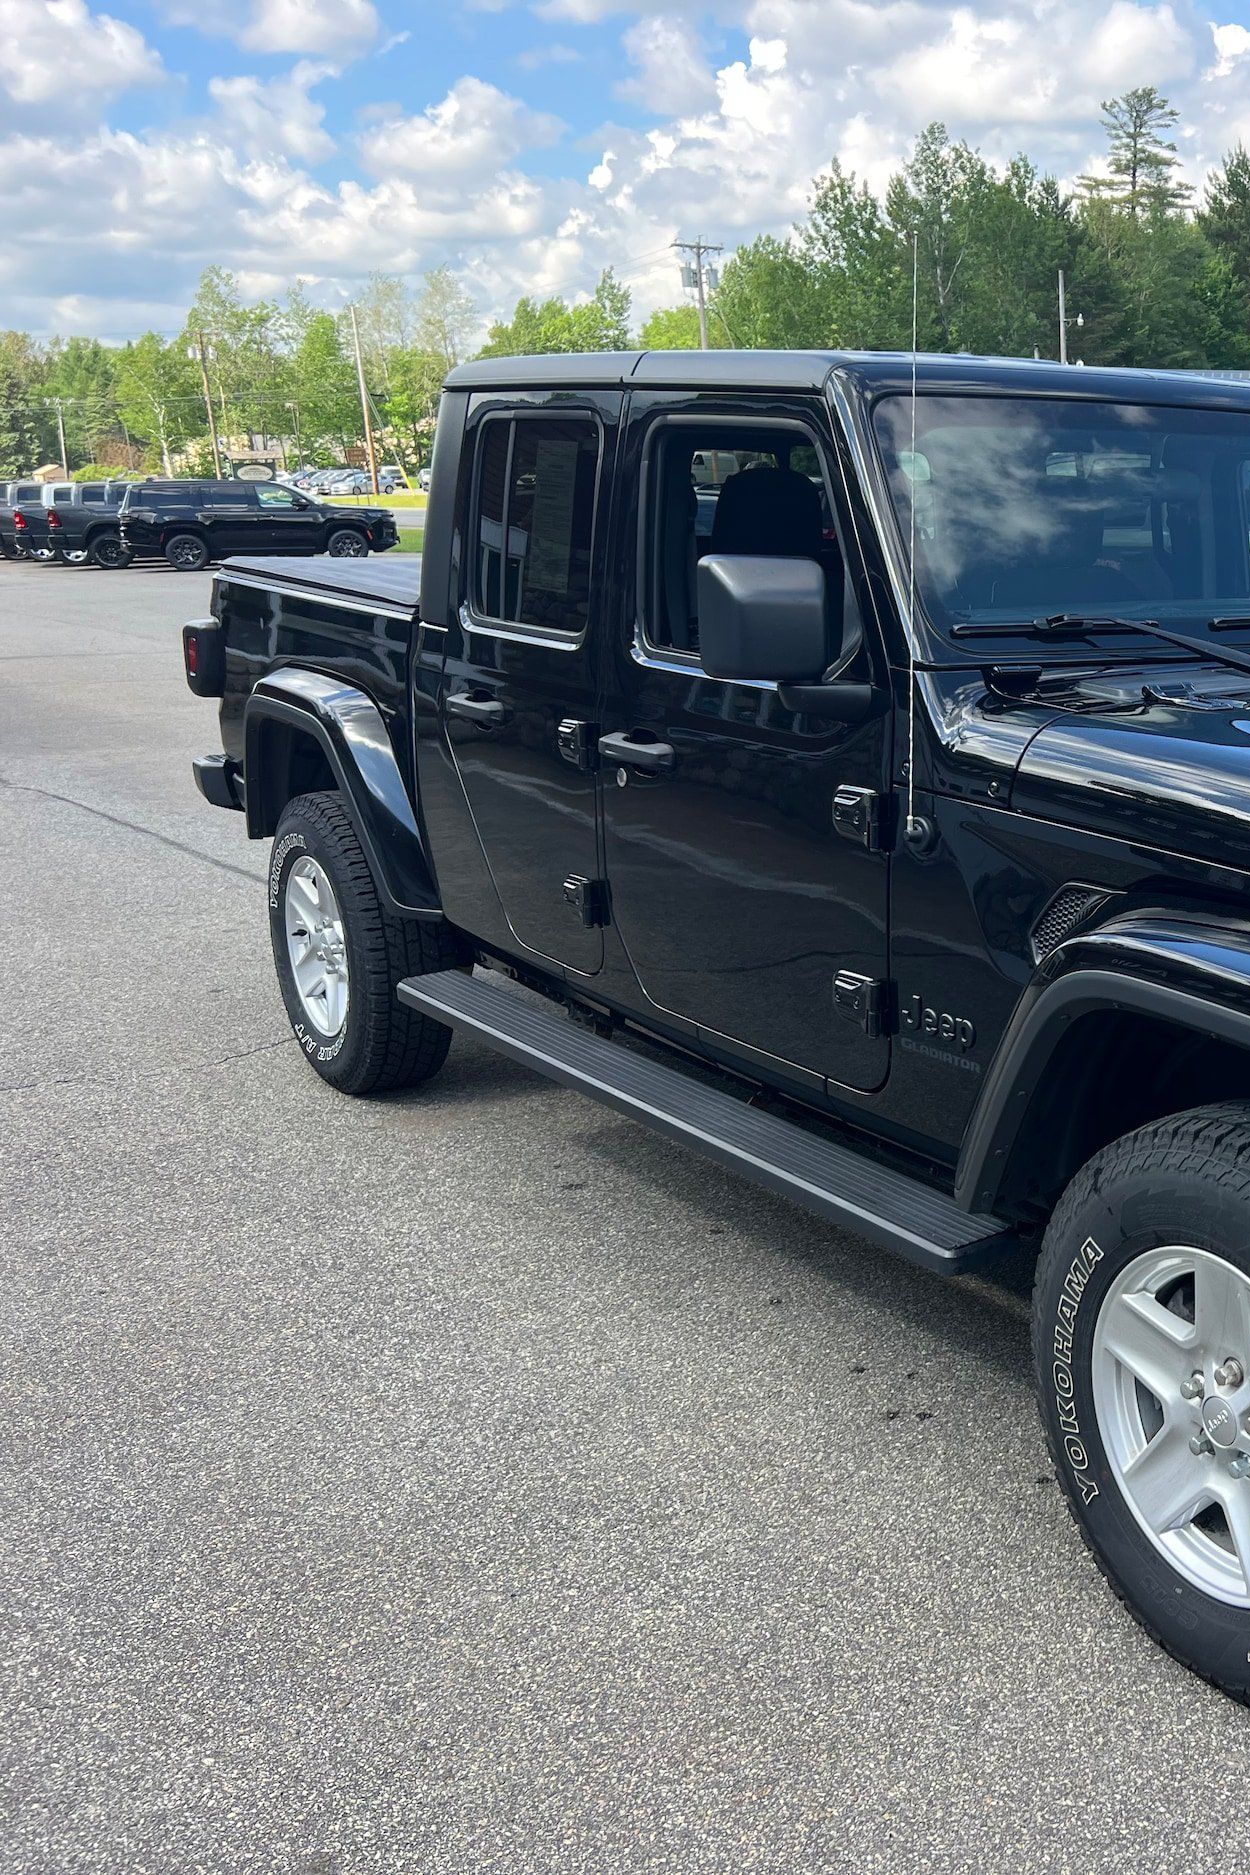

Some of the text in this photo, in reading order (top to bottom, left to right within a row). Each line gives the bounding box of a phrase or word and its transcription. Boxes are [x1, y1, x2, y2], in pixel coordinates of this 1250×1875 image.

[294, 1023, 317, 1053] A/T
[902, 995, 976, 1053] Jeep
[900, 1036, 981, 1074] GLADIATOR
[1052, 1236, 1104, 1506] YOKOHAMA
